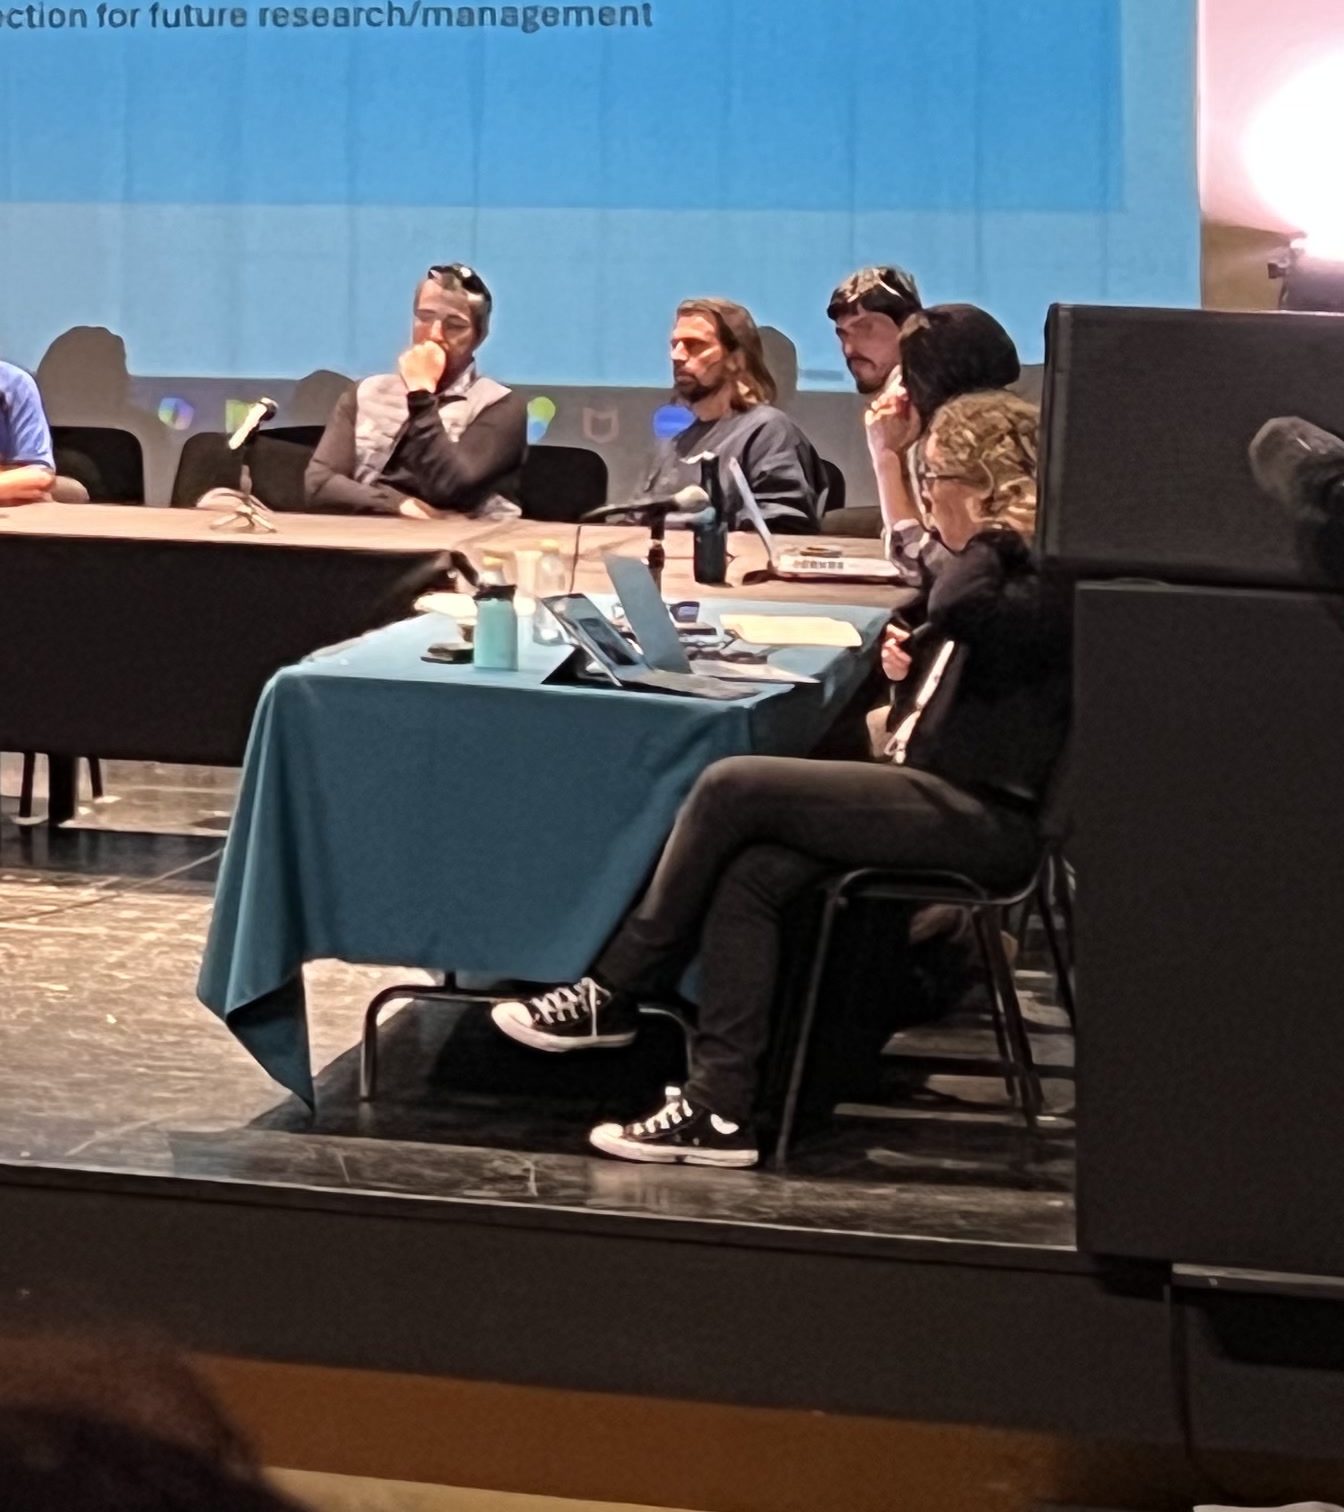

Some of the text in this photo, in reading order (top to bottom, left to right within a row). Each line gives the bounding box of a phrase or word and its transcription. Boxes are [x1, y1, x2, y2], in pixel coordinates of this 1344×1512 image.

[96, 2, 140, 28] for
[149, 1, 247, 29] future
[259, 0, 653, 34] research/management
